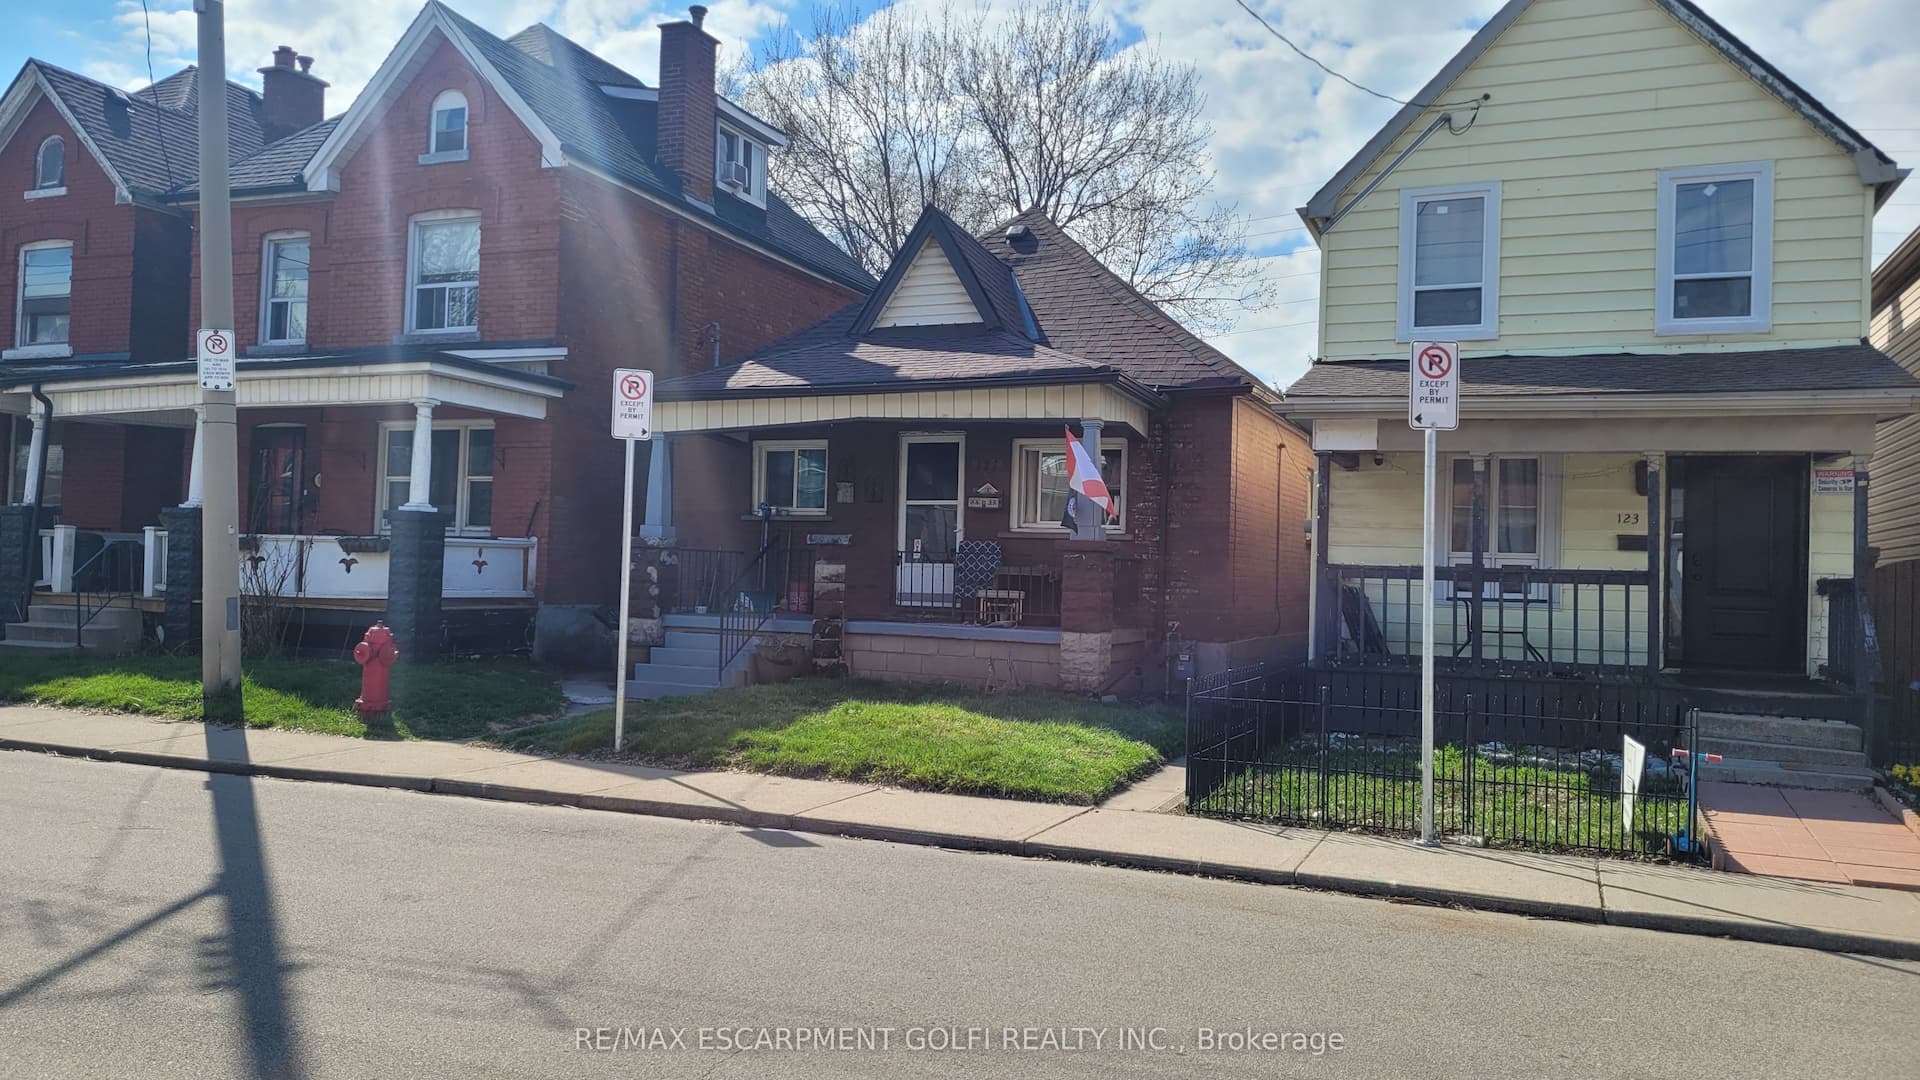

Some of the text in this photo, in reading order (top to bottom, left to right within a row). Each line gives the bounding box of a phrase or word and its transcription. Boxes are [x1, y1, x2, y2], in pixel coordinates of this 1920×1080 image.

[1419, 380, 1449, 388] EXCEPT
[1429, 388, 1440, 396] BY
[1419, 396, 1449, 404] PERMIT
[619, 412, 644, 420] PERMIT
[1617, 512, 1640, 525] 123
